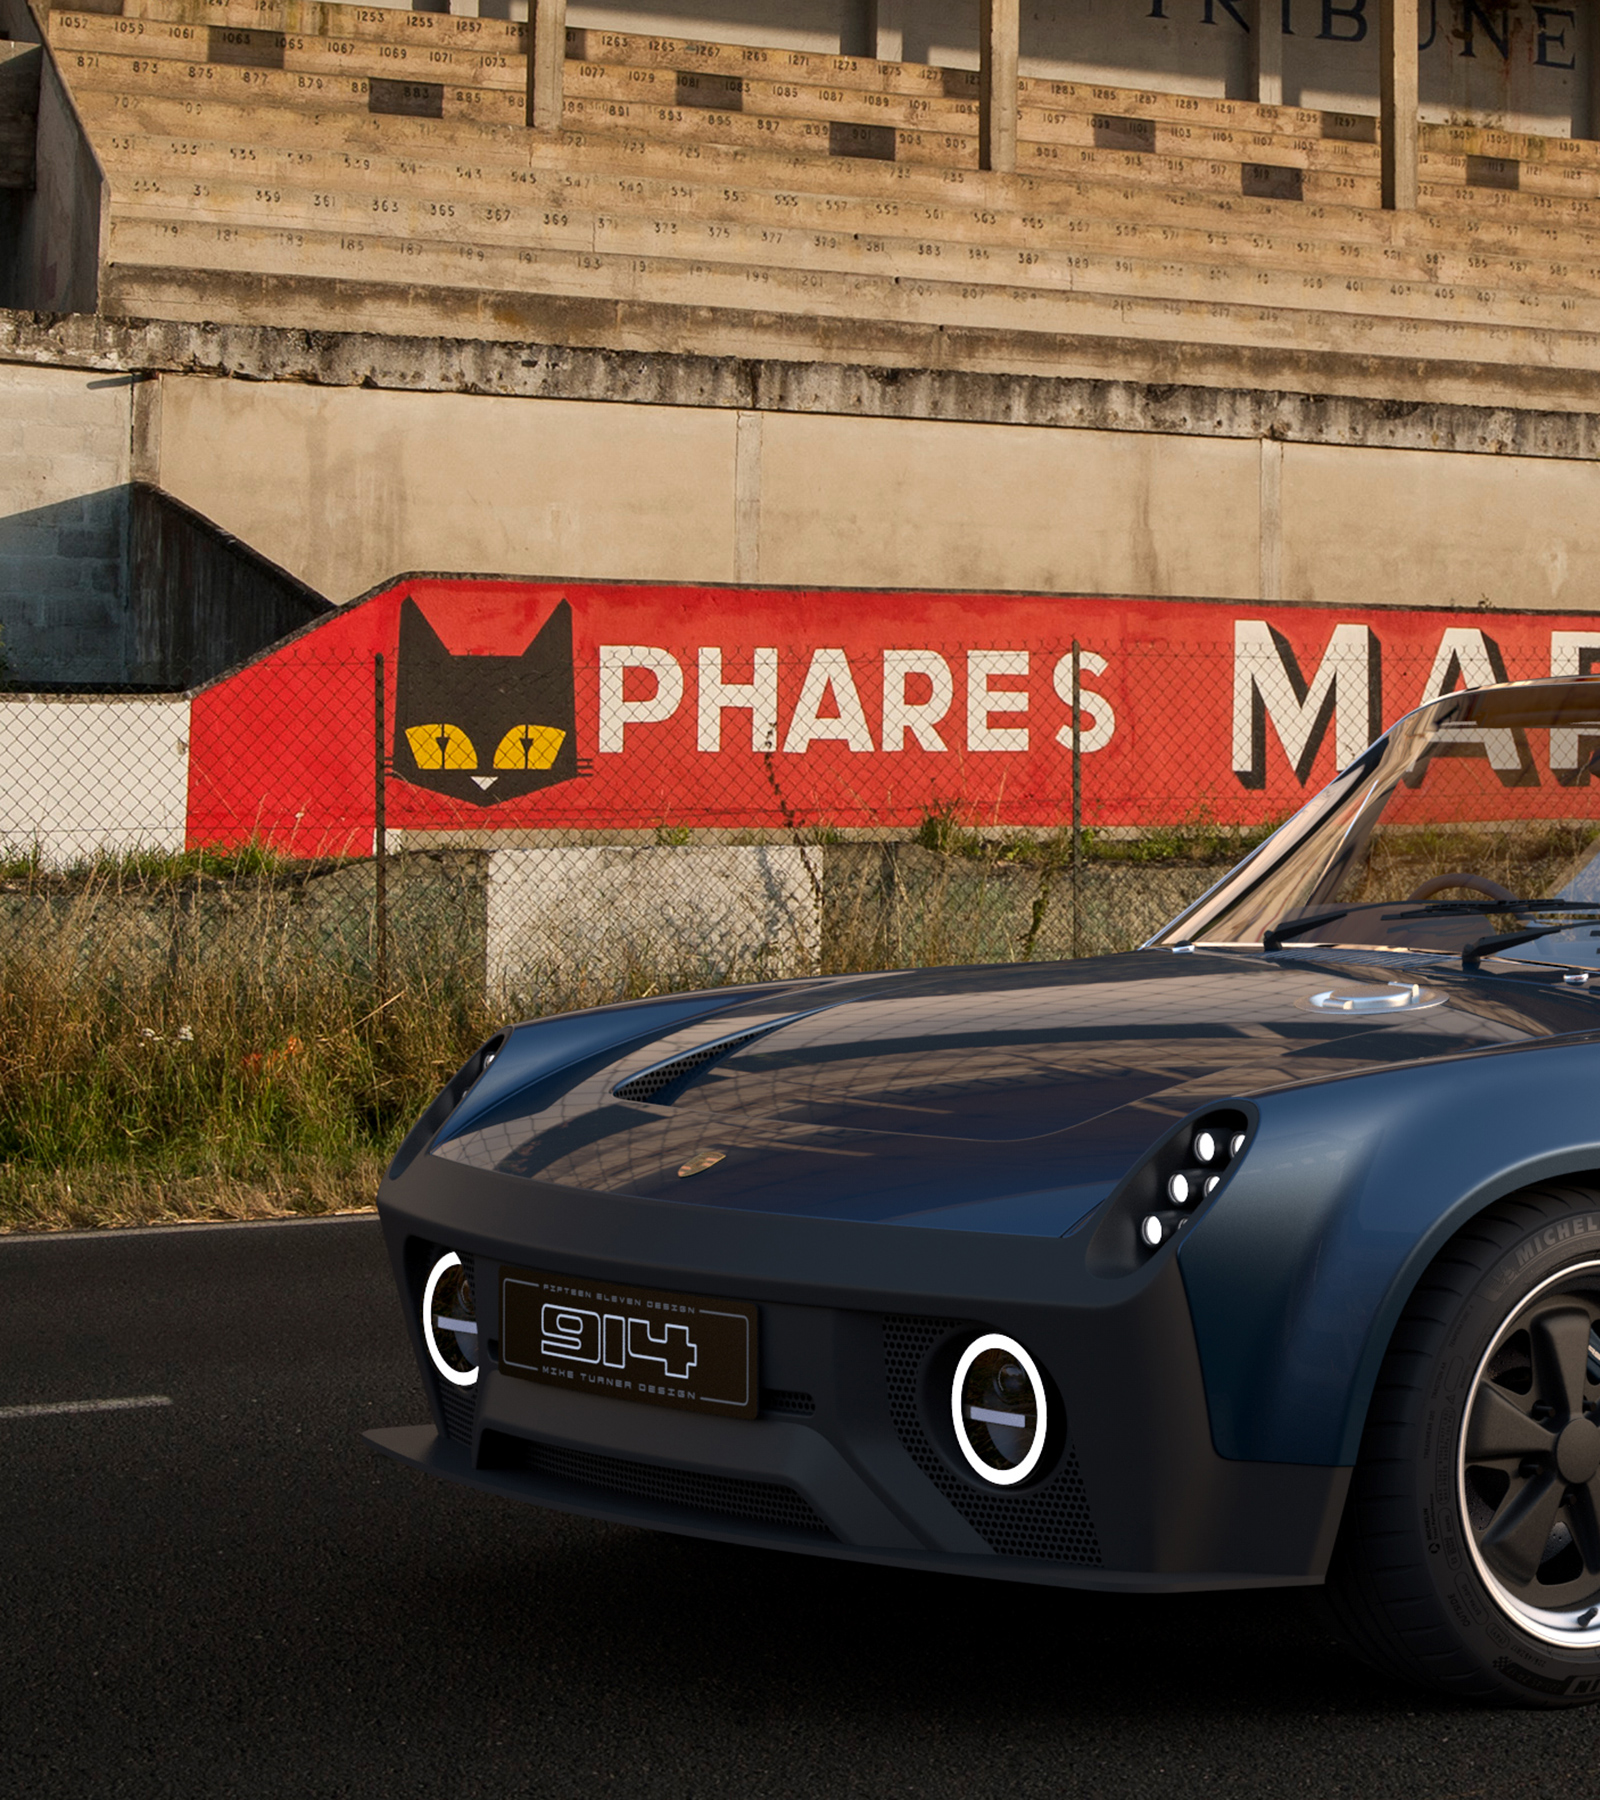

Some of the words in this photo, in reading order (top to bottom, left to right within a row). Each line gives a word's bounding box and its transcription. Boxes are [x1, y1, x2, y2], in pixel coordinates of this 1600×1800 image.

[357, 11, 384, 22] 1253
[407, 16, 433, 27] 1255
[60, 17, 87, 29] 1057
[114, 21, 144, 34] 1059
[457, 21, 482, 32] 1257
[169, 27, 194, 39] 1061
[222, 33, 250, 45] 1063
[275, 38, 304, 50] 1065
[602, 35, 628, 47] 1263
[650, 40, 675, 52] 1265
[328, 42, 354, 54] 1067
[380, 47, 407, 59] 1069
[695, 46, 720, 57] 1267
[430, 52, 452, 63] 1071
[742, 50, 767, 61] 1269
[789, 55, 809, 66] 1271
[78, 57, 99, 68] 871
[133, 61, 158, 73] 873
[480, 56, 506, 68] 1073
[834, 59, 858, 71] 1273
[189, 67, 213, 79] 875
[243, 72, 267, 84] 877
[580, 66, 605, 78] 1077
[628, 70, 654, 82] 1079
[921, 70, 944, 80] 1277
[298, 77, 322, 89] 879
[677, 77, 699, 89] 1081
[725, 80, 750, 93] 1083
[404, 87, 429, 98] 883
[773, 86, 797, 98] 1085
[819, 90, 844, 101] 1087
[1051, 84, 1075, 96] 1283
[1092, 89, 1116, 100] 1285
[457, 92, 480, 103] 885
[864, 96, 889, 107] 1089
[609, 105, 629, 116] 891
[909, 100, 930, 111] 1091
[1175, 99, 1198, 110] 1289
[1216, 104, 1236, 114] 1291
[659, 110, 682, 121] 893
[1256, 108, 1278, 119] 1293
[708, 115, 731, 126] 895
[758, 120, 780, 131] 897
[805, 125, 828, 136] 899
[1171, 127, 1191, 139] 1103
[900, 134, 921, 145] 903
[946, 139, 966, 148] 905
[1253, 136, 1272, 146] 1107
[256, 190, 280, 202] 359
[373, 200, 398, 212] 363
[430, 204, 454, 216] 365
[486, 210, 510, 221] 367
[544, 214, 568, 226] 369
[708, 227, 730, 238] 375
[761, 232, 782, 244] 377
[918, 245, 941, 256] 383
[599, 645, 1116, 754] PHARES
[543, 1283, 592, 1299] FIFTEEN
[596, 1293, 642, 1306] ELEVEN
[646, 1301, 695, 1314] DESIGN
[541, 1303, 698, 1379] 914
[542, 1365, 574, 1379] MIKE
[580, 1373, 632, 1389] TURNER
[638, 1383, 696, 1400] DESIGN
[1424, 1422, 1433, 1460] TREADWEAR
[1423, 1508, 1433, 1541] MICHELIN
[1447, 1593, 1471, 1628] OUTSIDE
